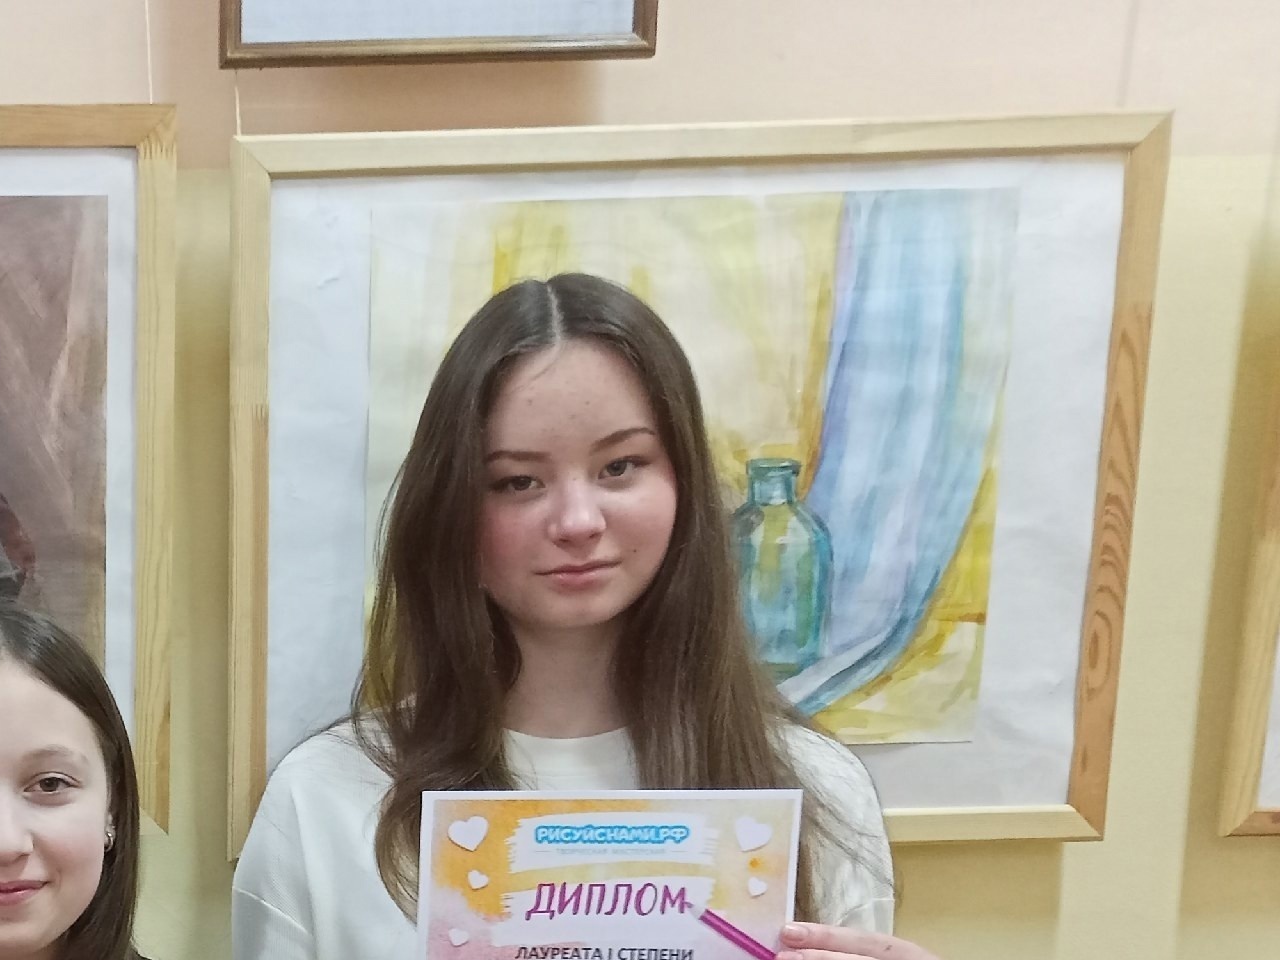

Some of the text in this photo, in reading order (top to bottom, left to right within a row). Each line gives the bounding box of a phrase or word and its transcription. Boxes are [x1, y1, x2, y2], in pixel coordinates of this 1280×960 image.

[536, 825, 689, 843] РИСУЙСНАМИ.РФ
[525, 881, 691, 921] ДИПЛОМ
[514, 946, 604, 960] ЛАУРЕАТА
[617, 948, 695, 960] СТЕПЕНИ
